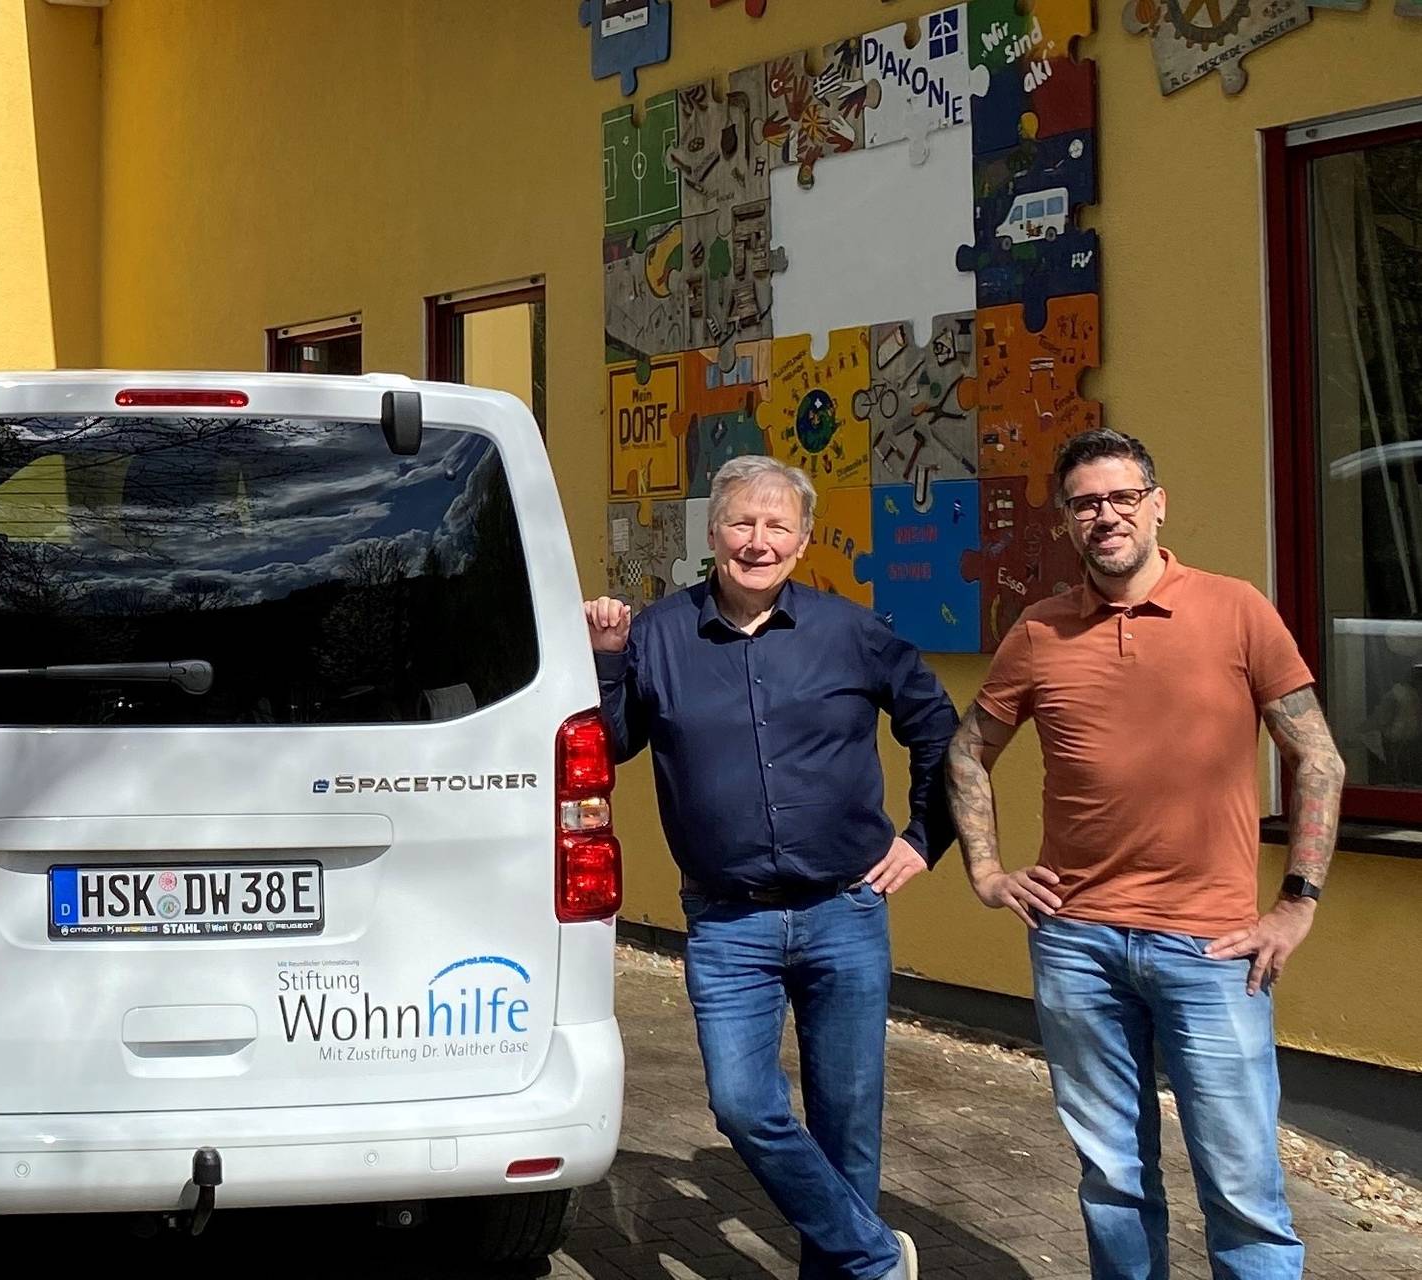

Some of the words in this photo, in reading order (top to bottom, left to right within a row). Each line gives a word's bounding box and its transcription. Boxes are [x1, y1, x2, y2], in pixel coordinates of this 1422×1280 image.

[864, 37, 964, 125] DIAKONIE
[632, 388, 653, 402] Mein
[619, 403, 668, 445] DORF
[809, 526, 854, 560] LIER
[61, 903, 71, 916] D
[81, 874, 155, 917] HSK
[185, 872, 231, 915] DW
[162, 924, 201, 934] STAHL
[278, 970, 360, 994] Stiftung
[278, 987, 529, 1042] Wohnhilfe
[319, 1047, 343, 1061] Mit
[347, 1045, 417, 1063] Zustiftung
[423, 1044, 439, 1058] Dr.
[444, 1041, 495, 1057] Walther
[499, 1039, 529, 1053] Gase
